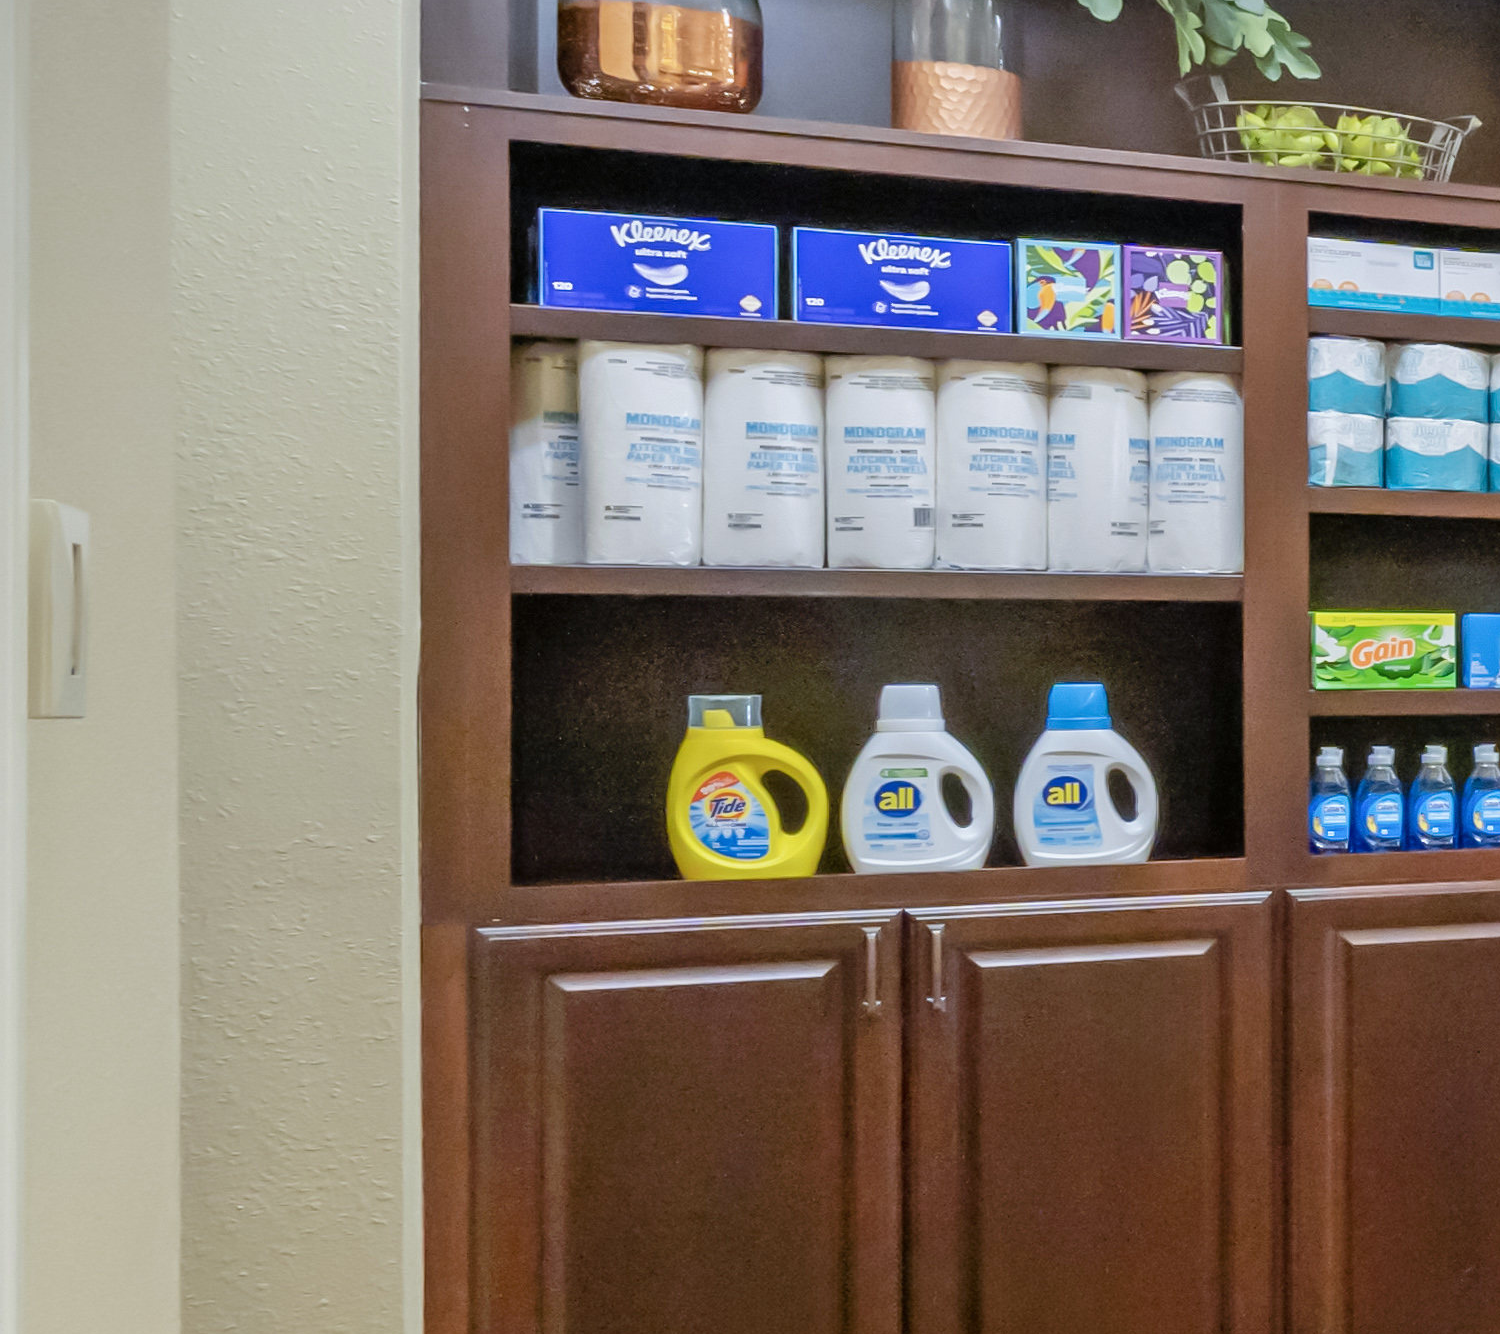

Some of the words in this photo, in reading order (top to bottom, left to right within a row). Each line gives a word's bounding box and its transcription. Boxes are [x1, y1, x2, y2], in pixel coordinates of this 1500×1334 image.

[610, 220, 712, 252] Kleenex
[635, 247, 663, 258] ultra
[664, 250, 688, 260] soft
[858, 238, 952, 269] Kleenex
[881, 265, 907, 275] ultra
[908, 267, 931, 276] soft
[844, 426, 926, 440] MONOGRAM
[967, 426, 1039, 441] MONOGRAM
[630, 442, 682, 454] KITCHEN
[1155, 436, 1224, 449] MONOGRAM
[627, 452, 662, 462] PAPER
[750, 451, 799, 463] KITCHEN
[849, 455, 897, 465] KITCHEN
[971, 454, 1018, 464] KITCHEN
[747, 460, 784, 471] PAPER
[847, 464, 882, 474] PAPER
[969, 463, 1005, 472] PAPER
[1351, 637, 1415, 669] Gain
[879, 786, 915, 810] all
[1047, 782, 1080, 805] all
[710, 797, 746, 819] Tide
